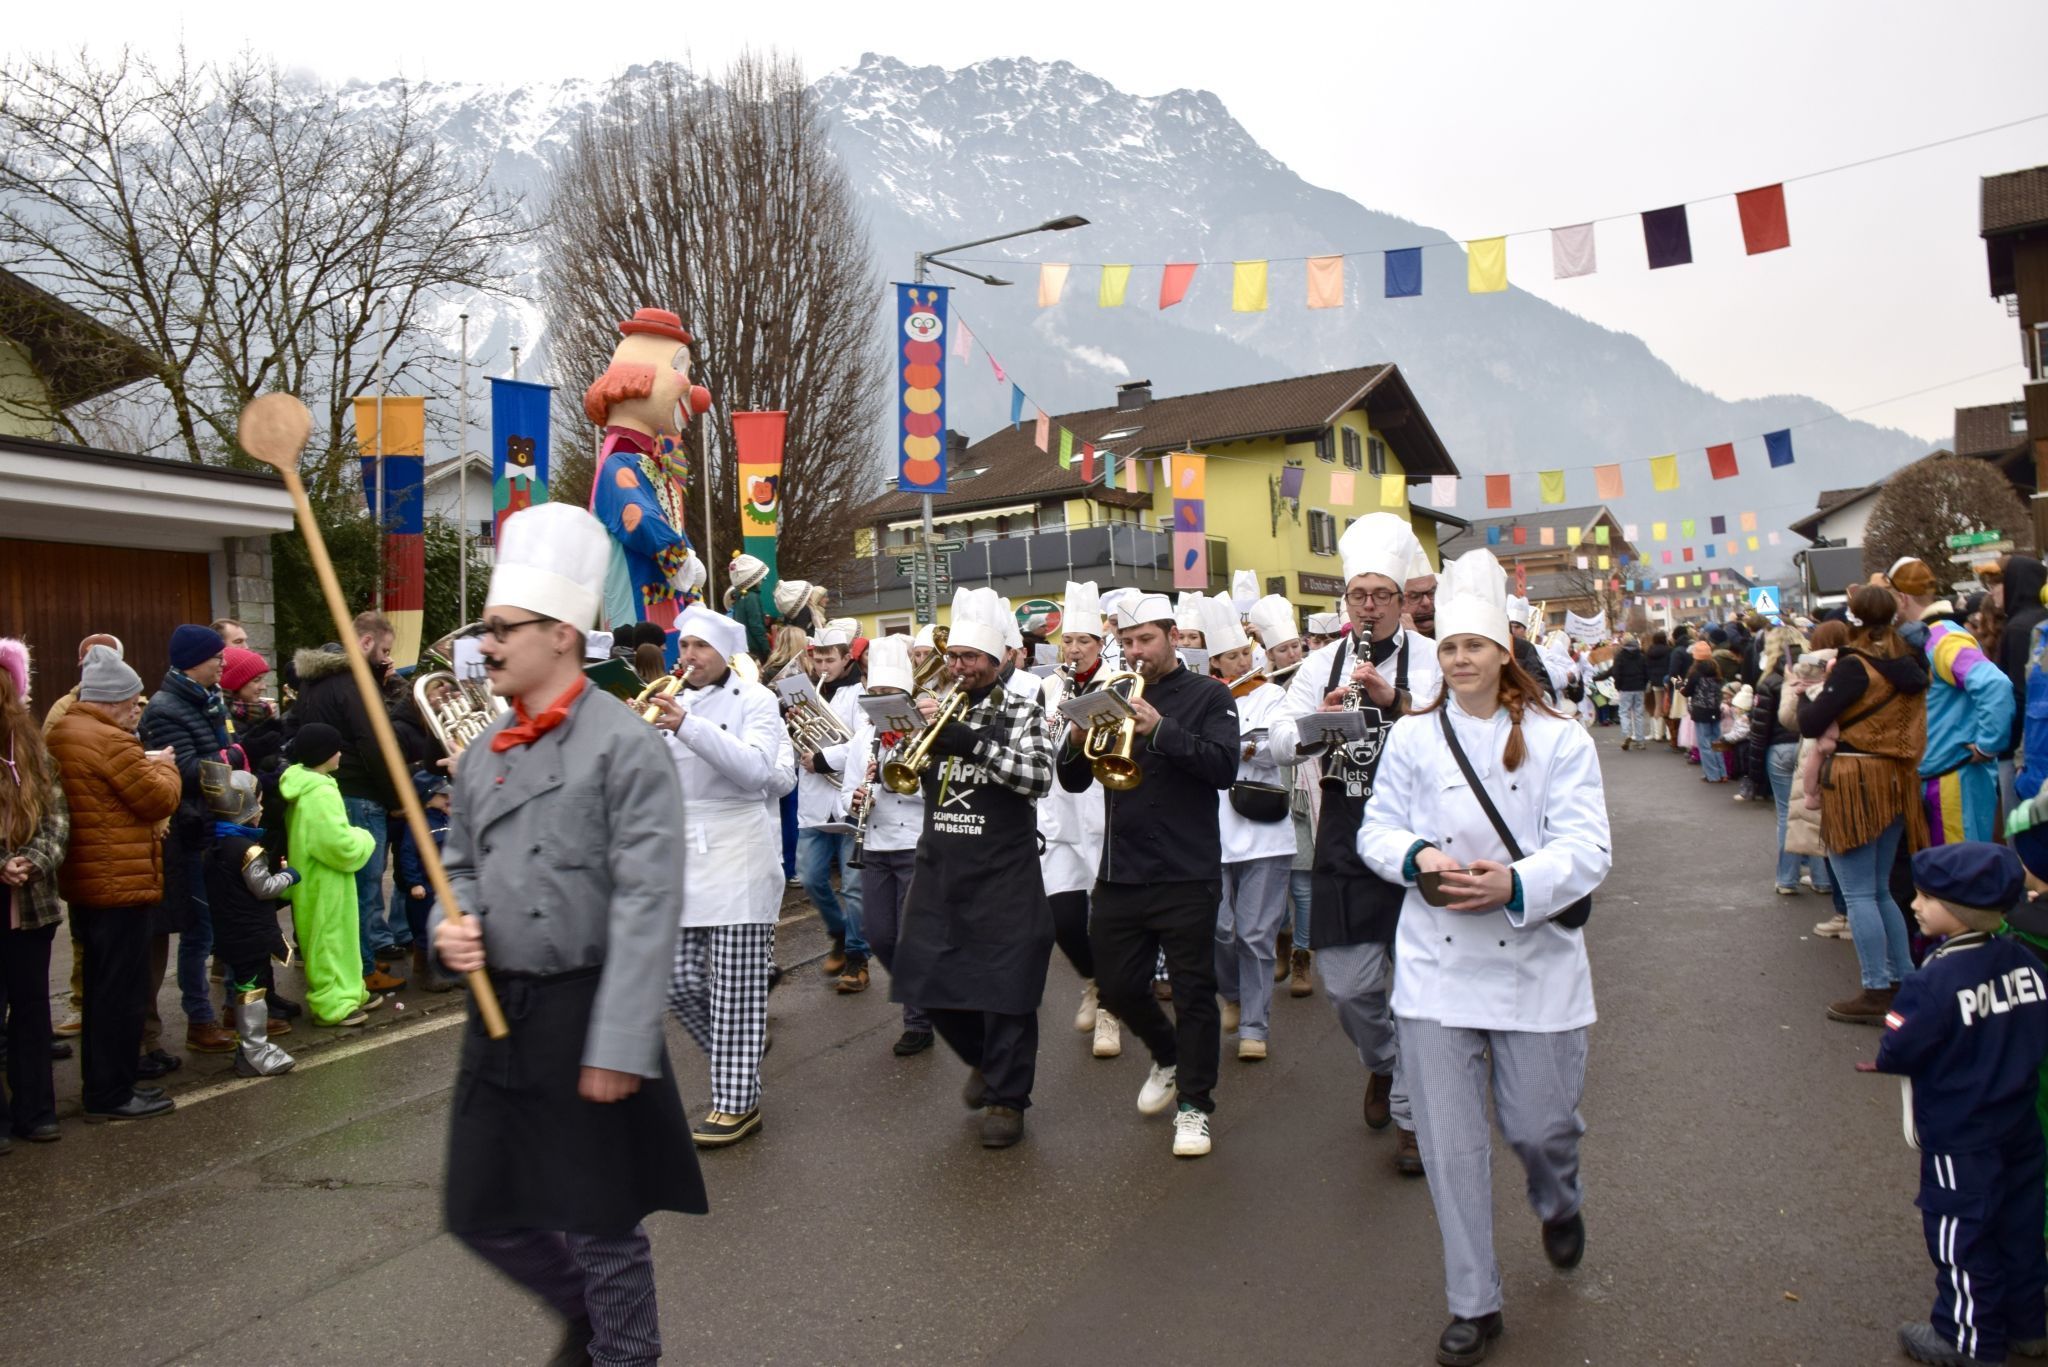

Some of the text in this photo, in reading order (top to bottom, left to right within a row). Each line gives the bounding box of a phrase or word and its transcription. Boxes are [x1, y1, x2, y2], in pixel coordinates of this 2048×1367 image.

[937, 760, 988, 784] PAPA
[1348, 782, 1373, 796] Co
[932, 811, 986, 824] SCHMECKT'S
[934, 822, 983, 835] AM BESTEN
